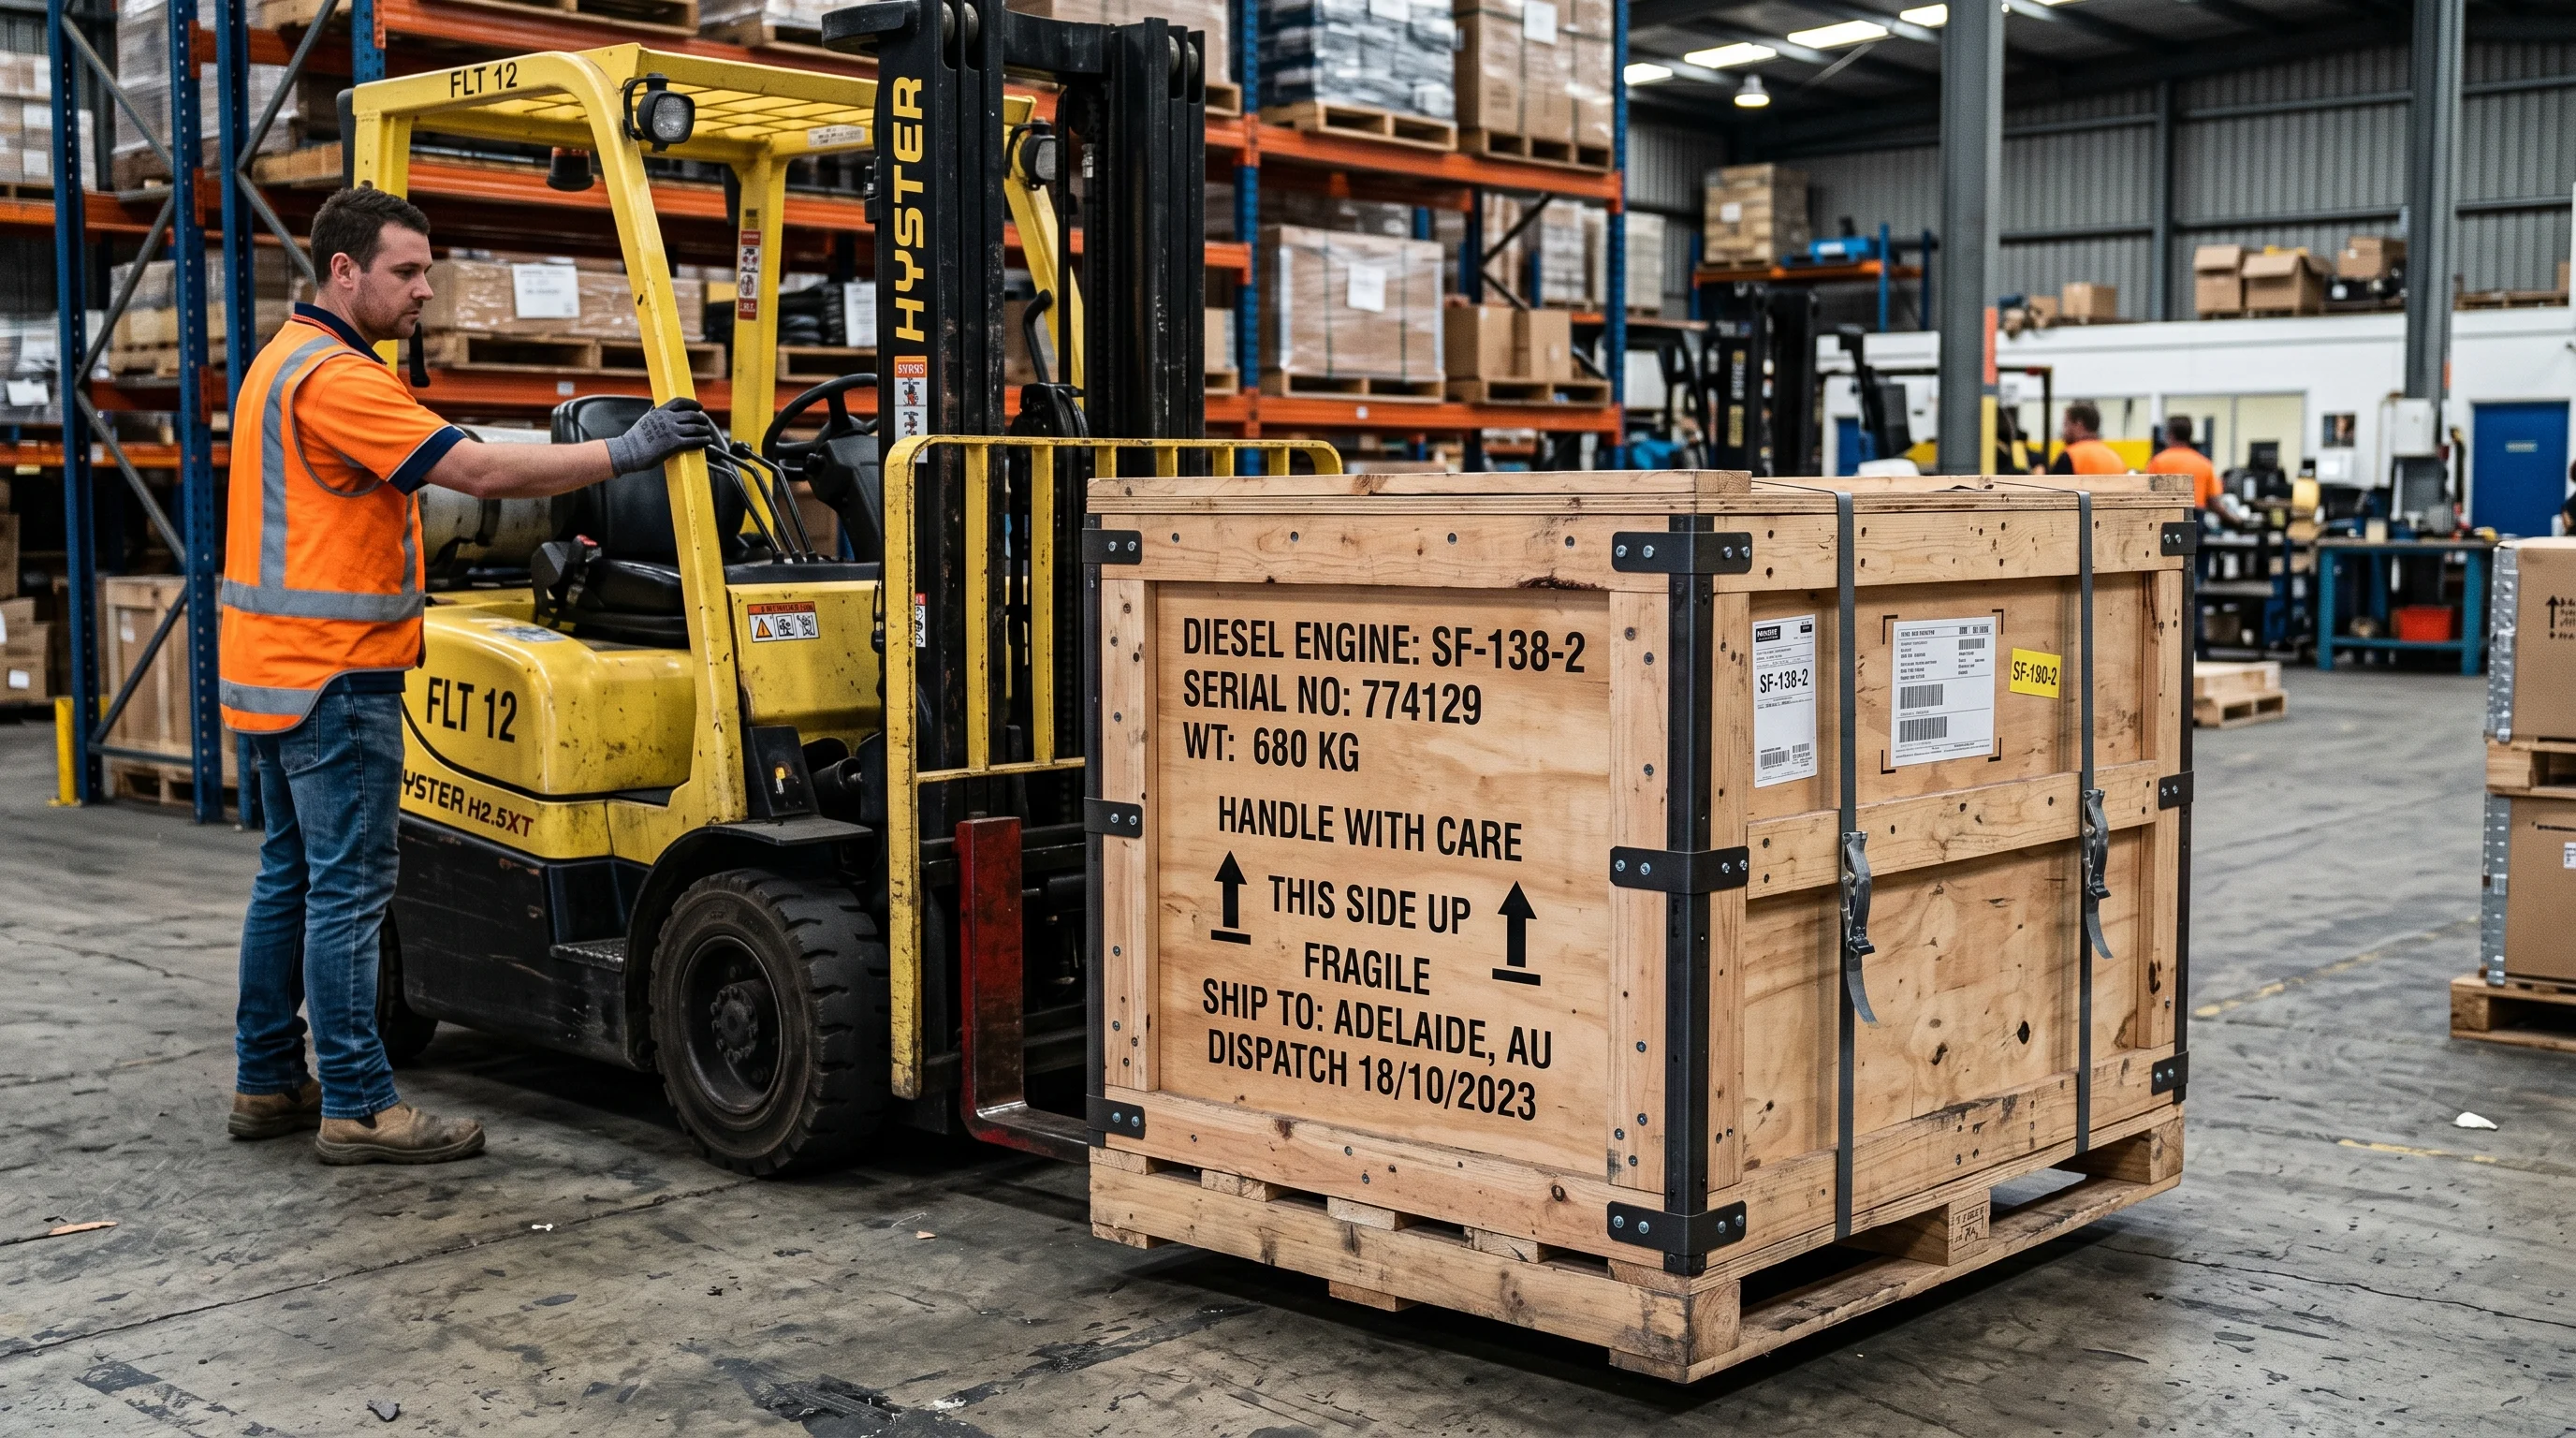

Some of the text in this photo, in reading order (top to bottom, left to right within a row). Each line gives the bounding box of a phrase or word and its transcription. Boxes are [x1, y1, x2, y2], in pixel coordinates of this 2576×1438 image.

[450, 62, 519, 98] FLT 12
[892, 77, 925, 344] HYSTER
[1183, 617, 1586, 673] DIESEL ENGINE: SF-138-2
[426, 676, 518, 744] FLT 12
[1183, 668, 1482, 726] SERIAL NO: 774129
[1760, 668, 1808, 694] SF-138-2
[1182, 721, 1359, 772] WT: 680 KG
[402, 769, 535, 838] YSTER H2.5XT
[1219, 795, 1523, 862] HANDLE WITH CARE
[1267, 874, 1471, 935] THIS SIDE UP
[1305, 941, 1430, 996] FRAGILE
[1203, 977, 1552, 1069] SHIP TO: ADELAIDE, AU
[1208, 1028, 1536, 1122] DISPATCH 18/10/2023
